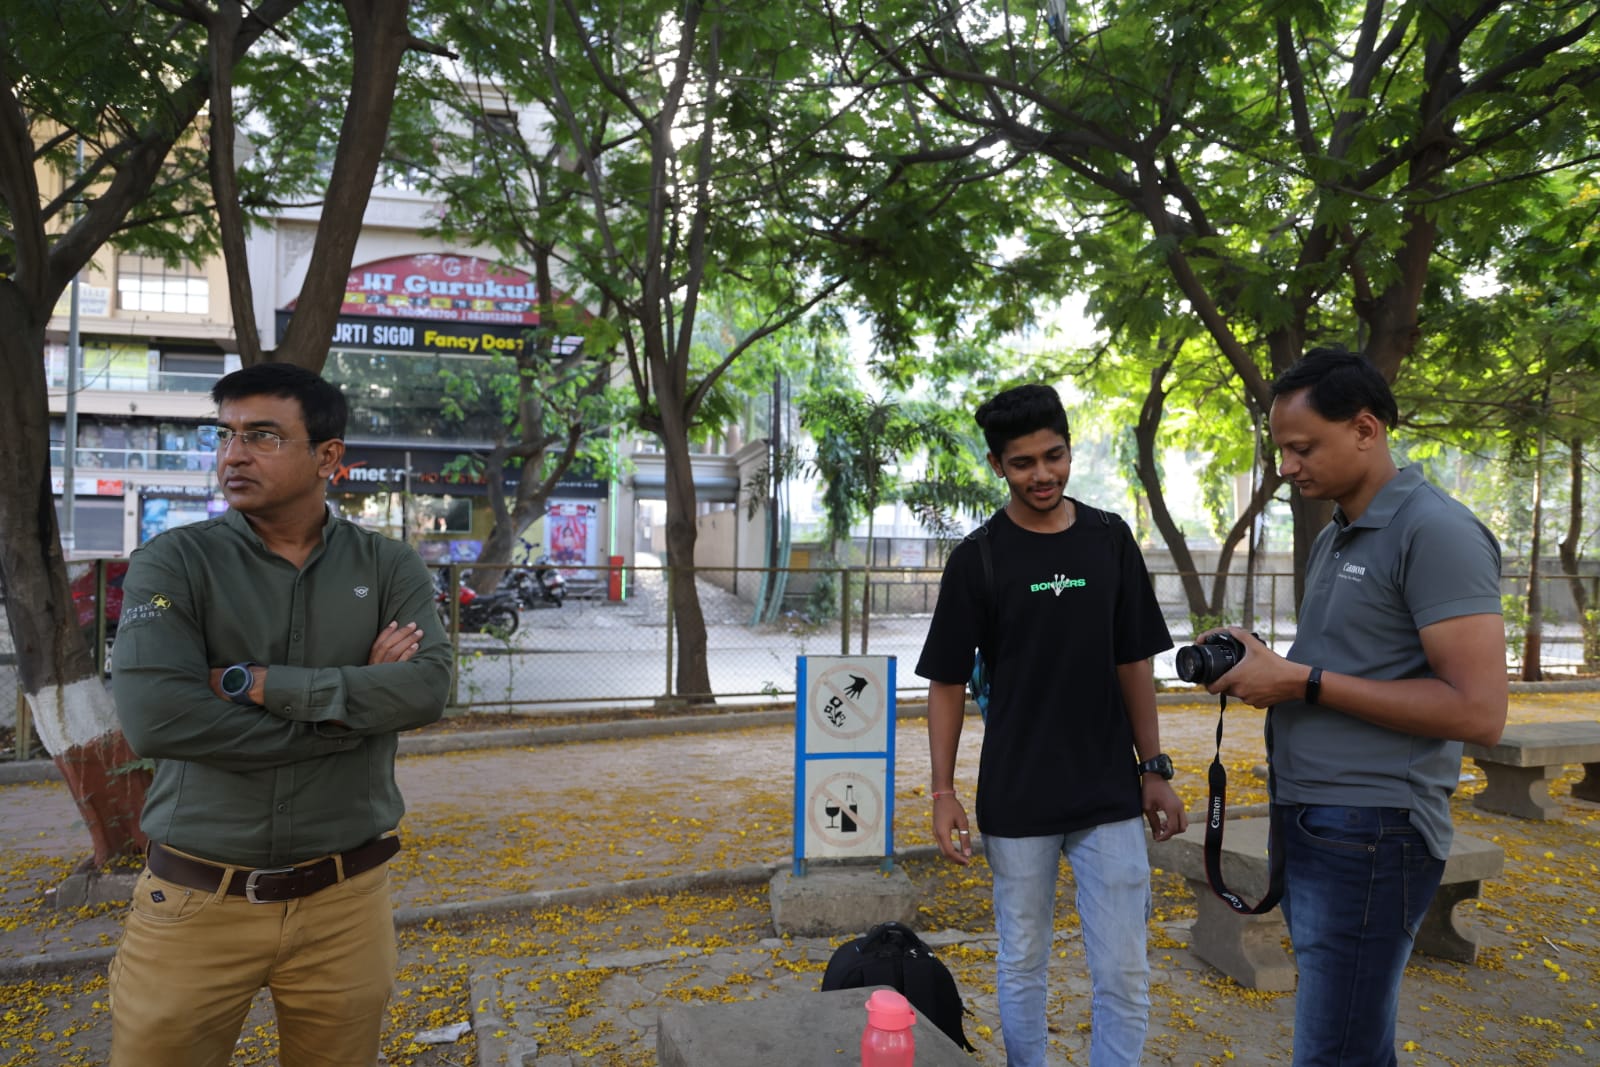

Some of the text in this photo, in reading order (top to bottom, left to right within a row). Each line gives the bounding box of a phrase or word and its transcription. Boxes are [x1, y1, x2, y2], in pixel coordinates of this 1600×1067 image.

[404, 275, 537, 299] Gurukul
[373, 325, 415, 346] SIGDI
[423, 330, 479, 353] Fancy
[1343, 562, 1366, 576] Canon
[1211, 796, 1221, 829] Canon
